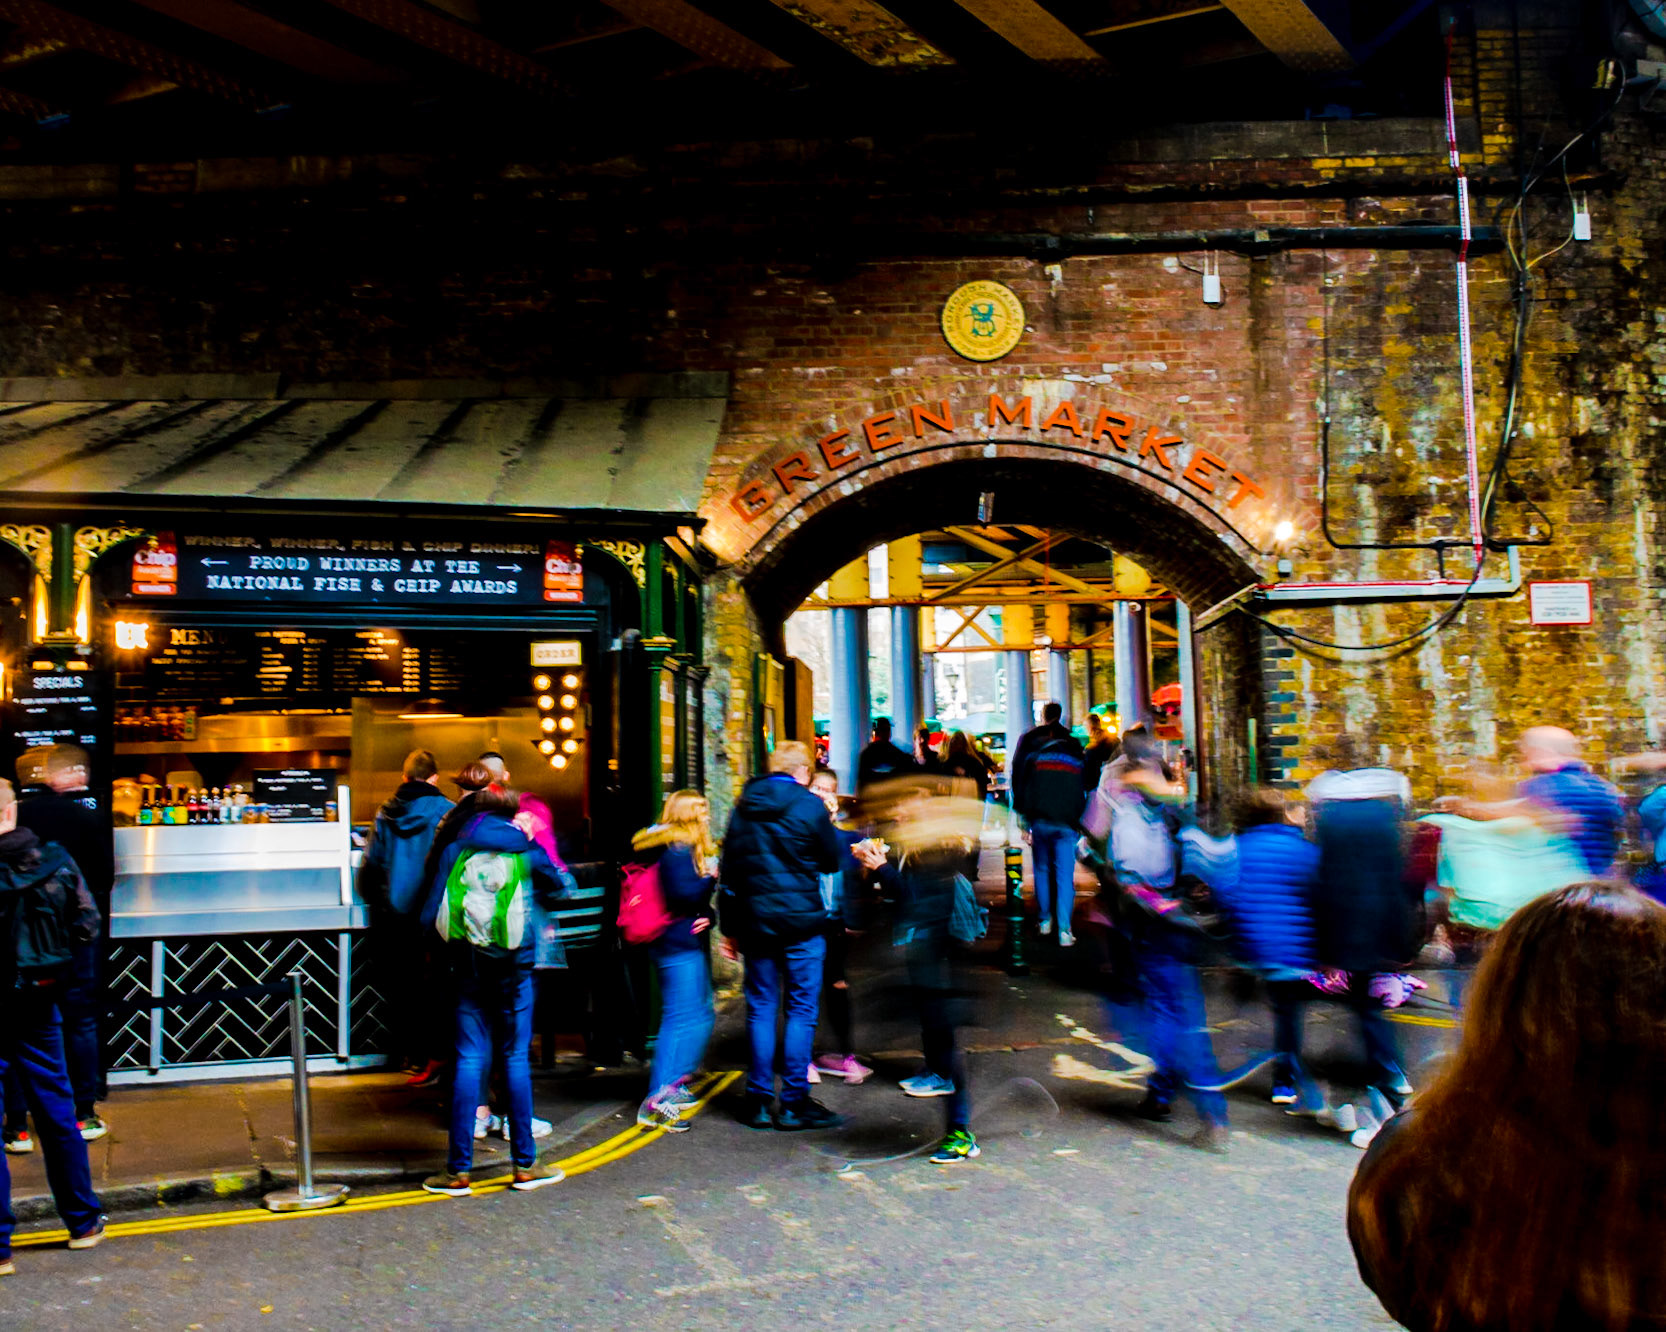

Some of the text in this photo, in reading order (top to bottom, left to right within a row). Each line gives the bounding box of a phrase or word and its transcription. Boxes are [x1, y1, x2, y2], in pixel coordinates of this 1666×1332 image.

[730, 394, 1266, 522] GREEN MARKET
[249, 555, 480, 574] PROUD WINNERS AT THE
[206, 575, 519, 595] NATIONAL FISH & CHIP AWARDS
